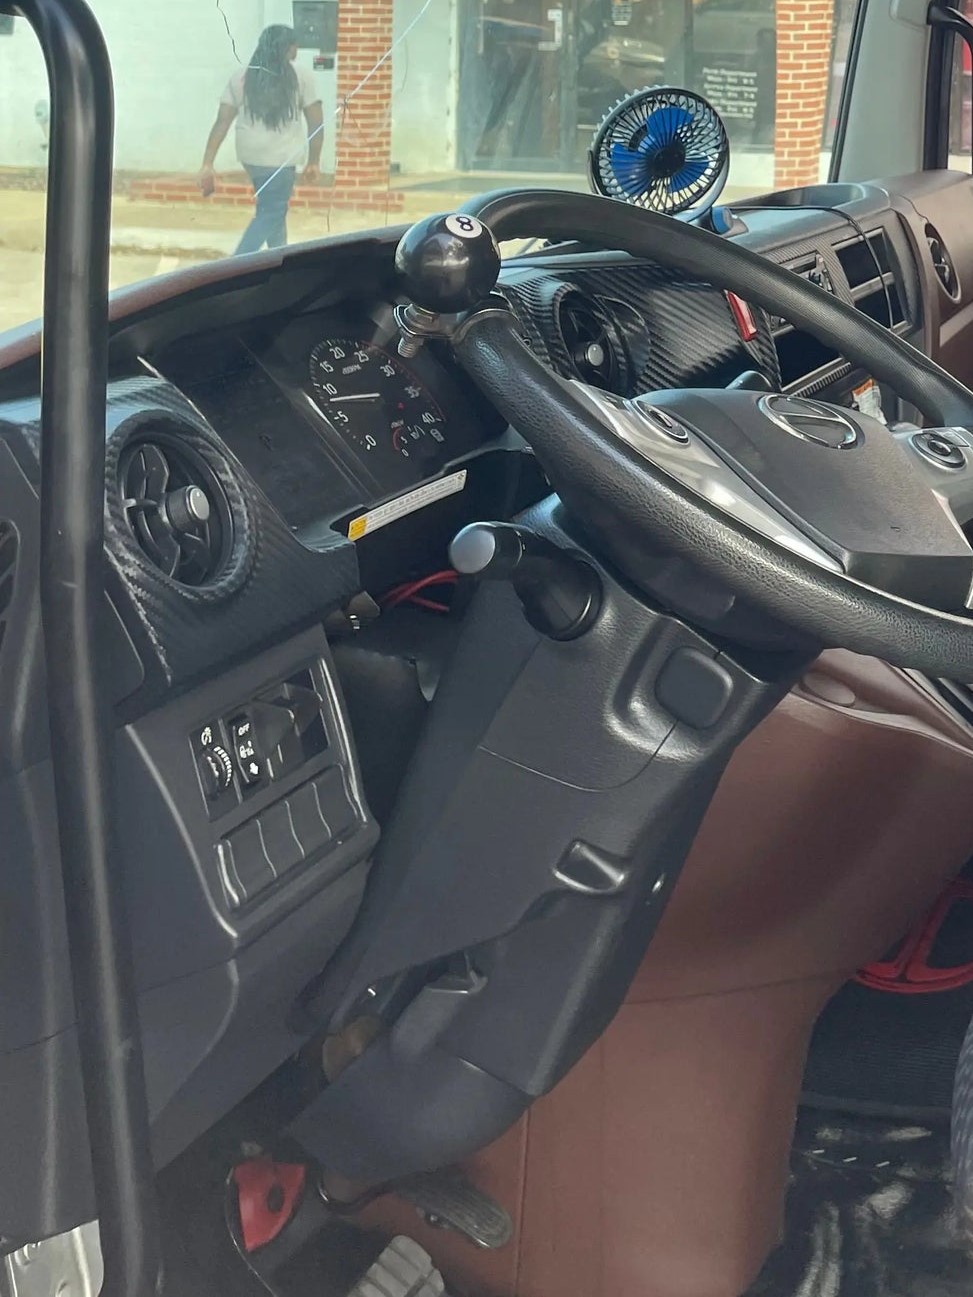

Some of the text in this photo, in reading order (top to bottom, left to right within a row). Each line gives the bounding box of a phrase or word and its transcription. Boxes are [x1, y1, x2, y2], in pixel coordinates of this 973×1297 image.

[456, 216, 474, 232] 8
[329, 346, 345, 360] 20
[354, 350, 369, 363] 25
[320, 360, 334, 373] 15
[380, 364, 396, 377] 30
[323, 383, 338, 395] 10
[404, 385, 420, 399] 35
[338, 411, 349, 423] 5
[421, 412, 436, 424] 40
[365, 434, 377, 447] 0
[238, 723, 250, 735] OFF
